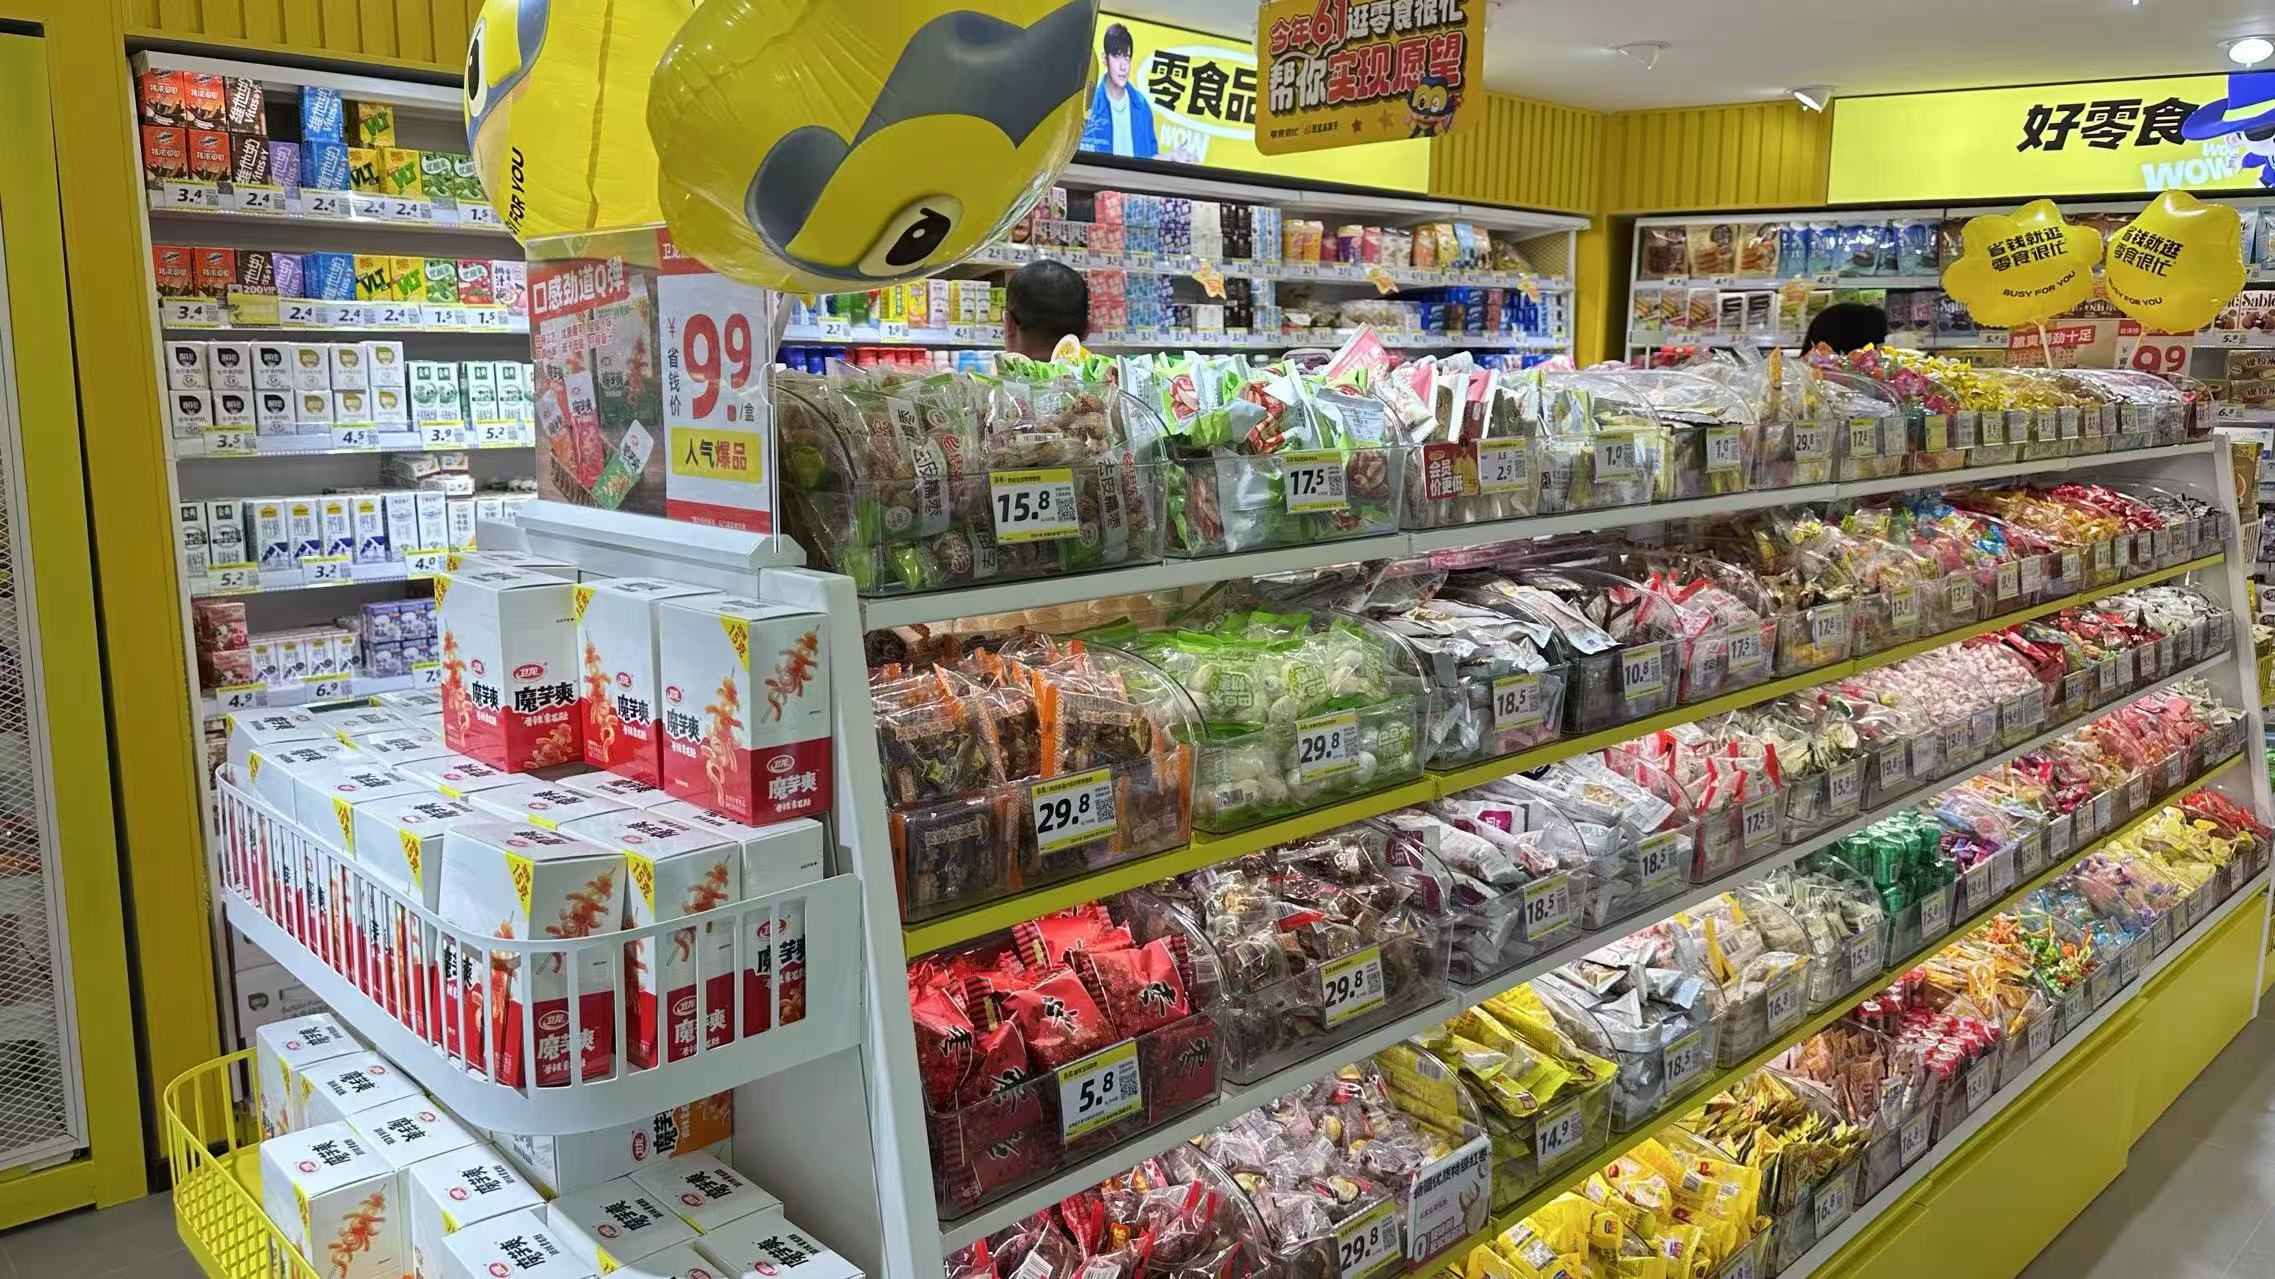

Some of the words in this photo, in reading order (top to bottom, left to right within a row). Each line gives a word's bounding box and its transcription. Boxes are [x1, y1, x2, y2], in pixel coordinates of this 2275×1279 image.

[1269, 33, 1464, 113] 帮你实现愿望
[1147, 50, 1257, 122] 零食品
[2017, 97, 2199, 152] 好零食
[512, 147, 525, 195] YOU
[178, 189, 201, 203] 3.4
[246, 192, 270, 206] 2.4
[313, 197, 336, 212] 2.4
[396, 203, 417, 216] 2.4
[471, 208, 488, 221] 1.5
[1987, 226, 2063, 258] 省钱就逛
[2121, 225, 2184, 260] 省钱就逛
[1992, 240, 2068, 272] 零食很忙
[2114, 242, 2173, 278] 零食很忙
[2003, 288, 2032, 298] BUSY
[2034, 284, 2055, 296] FOR
[2057, 270, 2076, 286] YOU
[178, 305, 202, 320] 3.4
[2124, 294, 2142, 306] FOR
[2143, 295, 2164, 307] YOU
[289, 307, 312, 320] 2.4
[339, 309, 360, 322] 2.4
[384, 309, 404, 321] 2.4
[435, 311, 452, 323] 1.5
[478, 312, 495, 324] 1.5
[888, 326, 899, 335] 1.0
[667, 347, 681, 417] 省钱价
[217, 435, 240, 448] 3.5
[343, 431, 364, 443] 4.5
[432, 429, 451, 441] 3.9
[486, 427, 504, 440] 5.2
[1796, 433, 1815, 452] 29.8
[686, 438, 747, 470] 人气爆品
[1606, 445, 1622, 466] 1.0
[1716, 440, 1729, 459] 1.0
[1429, 459, 1451, 479] 会员
[1497, 465, 1512, 480] 2.9
[1290, 470, 1324, 497] 17.5
[1431, 475, 1463, 497] 价更低
[997, 490, 1050, 523] 15.8
[315, 565, 336, 578] 3.2
[416, 557, 435, 570] 4.0
[221, 572, 244, 586] 5.2
[1731, 640, 1750, 659] 17.5
[518, 665, 539, 678] 卫龙
[1625, 664, 1649, 686] 10.8
[229, 694, 252, 707] 4.9
[317, 683, 337, 696] 6.9
[472, 681, 500, 711] 魔芋爽
[514, 681, 574, 713] 魔芋爽
[617, 694, 650, 725] 魔芋爽
[1497, 693, 1526, 716] 18.5
[667, 708, 700, 742] 魔芋爽
[1301, 732, 1340, 764] 29.8
[771, 758, 792, 770] 卫龙
[768, 771, 817, 800] 魔芋爽
[1038, 793, 1090, 834] 29.8
[1747, 812, 1765, 833] 17.5
[1642, 852, 1666, 877] 18.5
[1527, 895, 1554, 925] 18.5
[1325, 970, 1363, 1007] 29.8
[1768, 995, 1789, 1016] 16.8
[546, 1014, 566, 1025] 卫龙
[538, 1026, 595, 1061] 魔芋爽
[1667, 1054, 1690, 1080] 18.5
[339, 1070, 376, 1094] 魔芋爽
[1079, 1071, 1114, 1113] 5.8
[387, 1117, 427, 1143] 魔芋爽
[1540, 1121, 1569, 1154] 14.9
[312, 1139, 351, 1167] 魔芋爽
[462, 1165, 503, 1195] 魔芋爽
[686, 1171, 733, 1200] 魔芋爽
[606, 1200, 652, 1232] 魔芋爽
[1816, 1195, 1835, 1224] 16.8
[501, 1236, 546, 1271] 魔芋爽
[759, 1236, 809, 1268] 魔芋爽
[1341, 1227, 1379, 1271] 29.8
